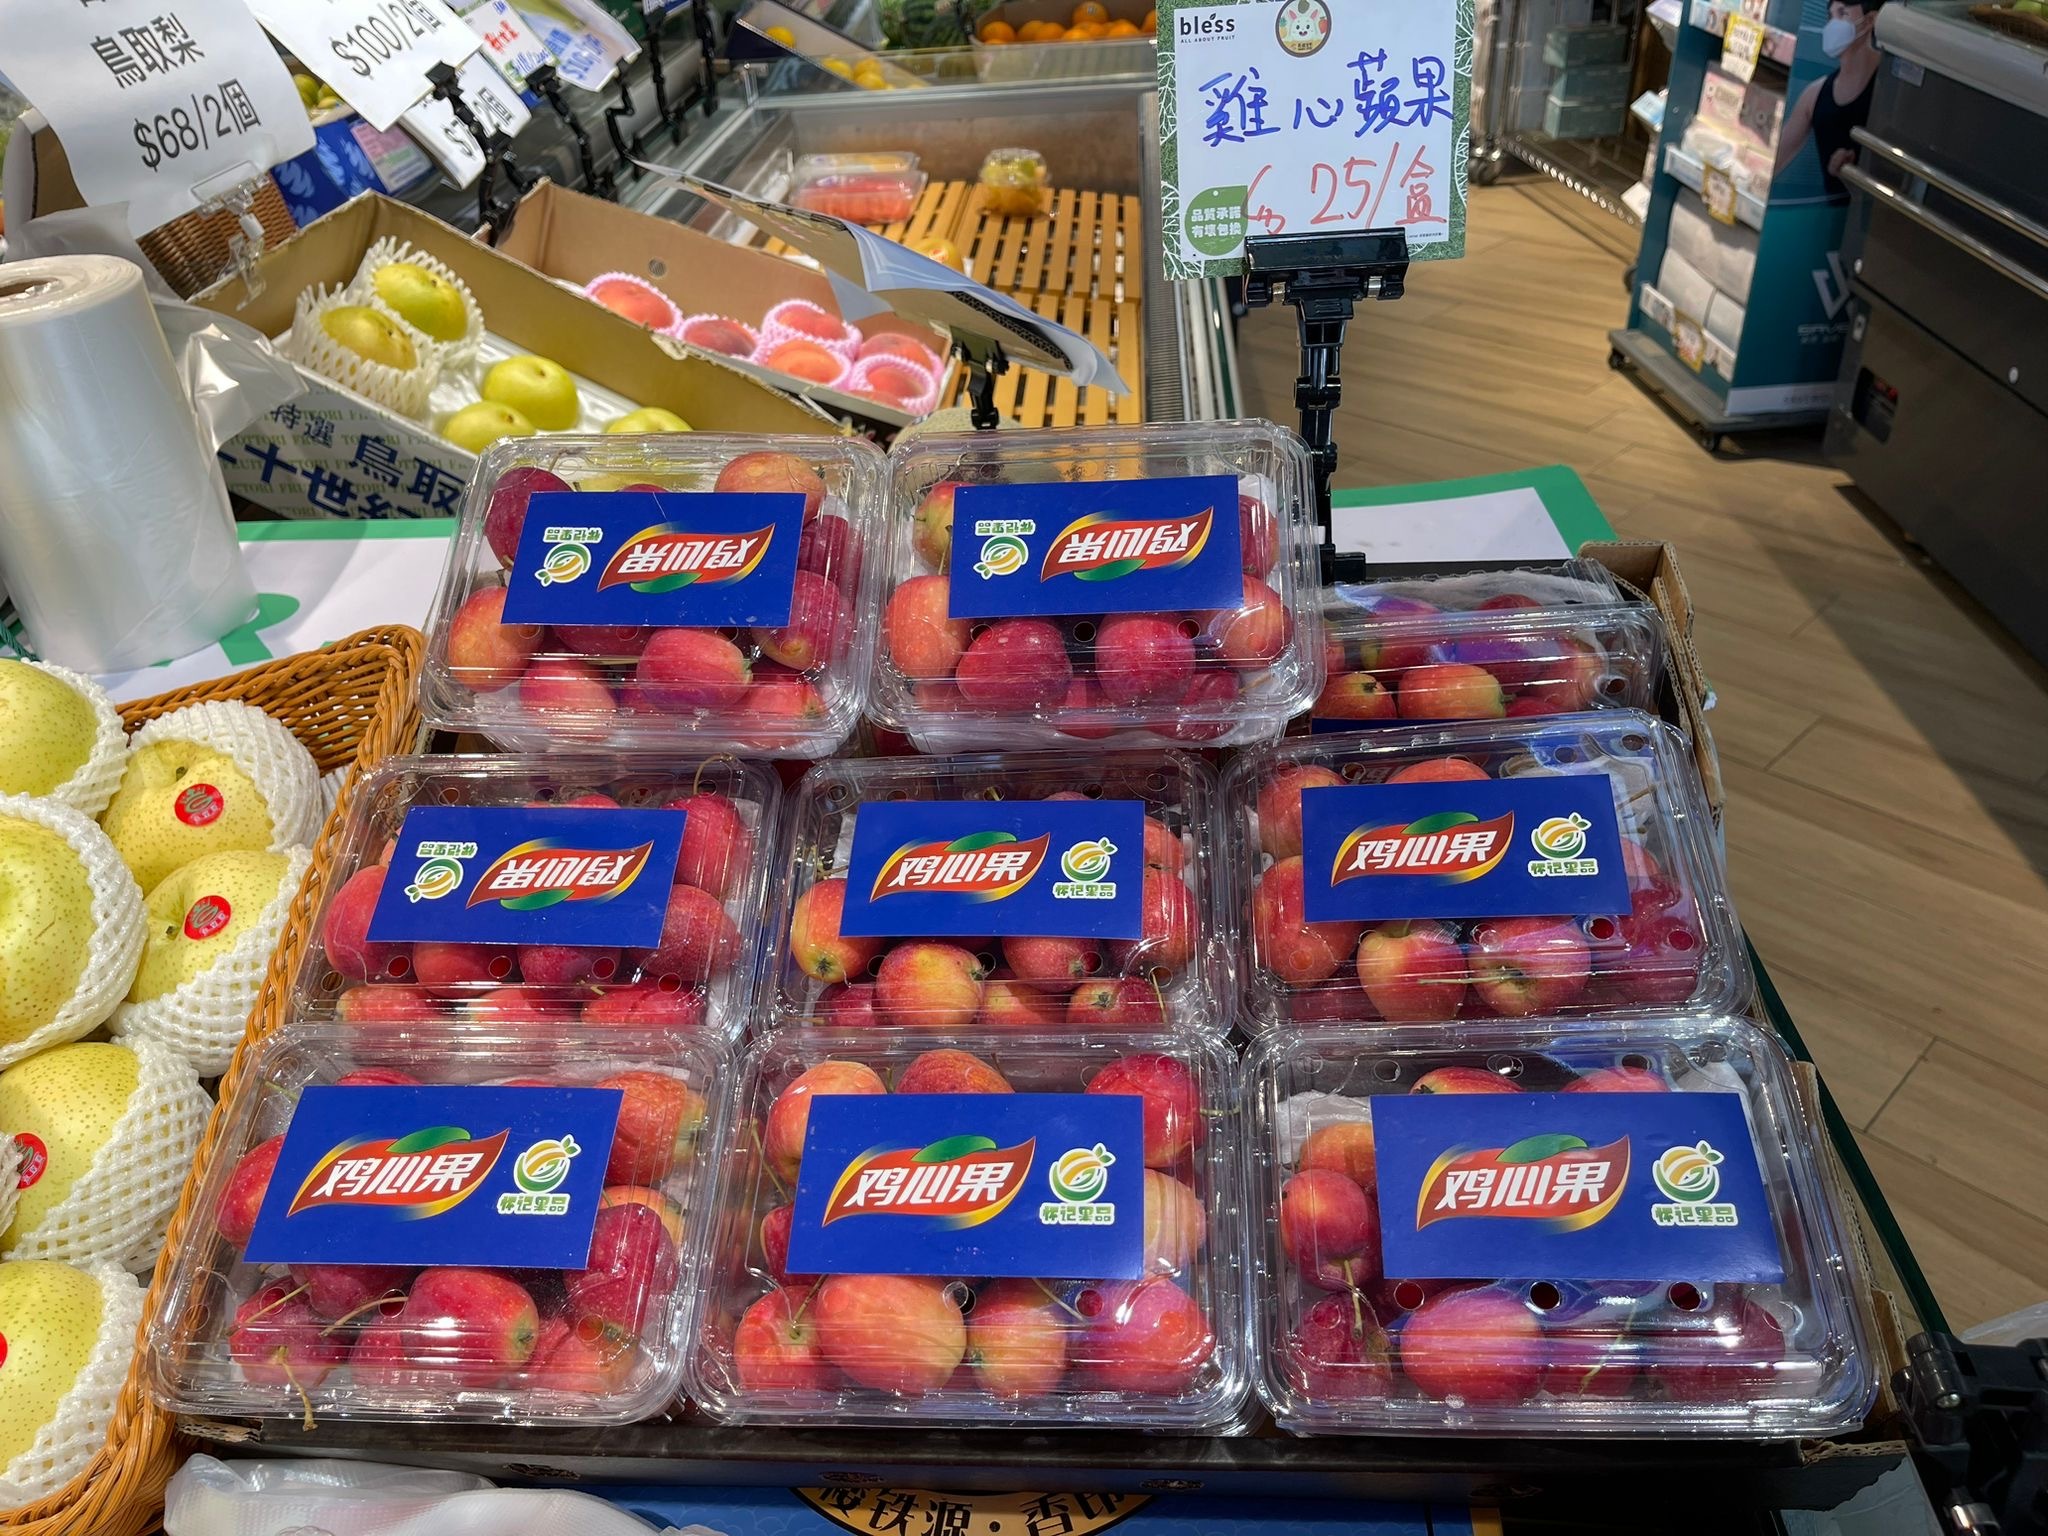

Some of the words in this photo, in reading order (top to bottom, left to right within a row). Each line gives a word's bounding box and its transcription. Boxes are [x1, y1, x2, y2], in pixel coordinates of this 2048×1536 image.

[1180, 14, 1235, 35] bless
[90, 12, 205, 89] 鳥取梨
[132, 78, 262, 173] $68/2個
[348, 434, 467, 516] 鳥取
[617, 536, 760, 575] 鸡心果
[1058, 520, 1200, 564] 鸡心果
[487, 853, 636, 890] 鸡心果
[887, 850, 1032, 888] 鸡心果
[1347, 829, 1498, 871] 鸡心果
[310, 1152, 486, 1197] 鸡心果
[842, 1161, 1016, 1208] 鸡心果
[1433, 1160, 1611, 1211] 鸡心果
